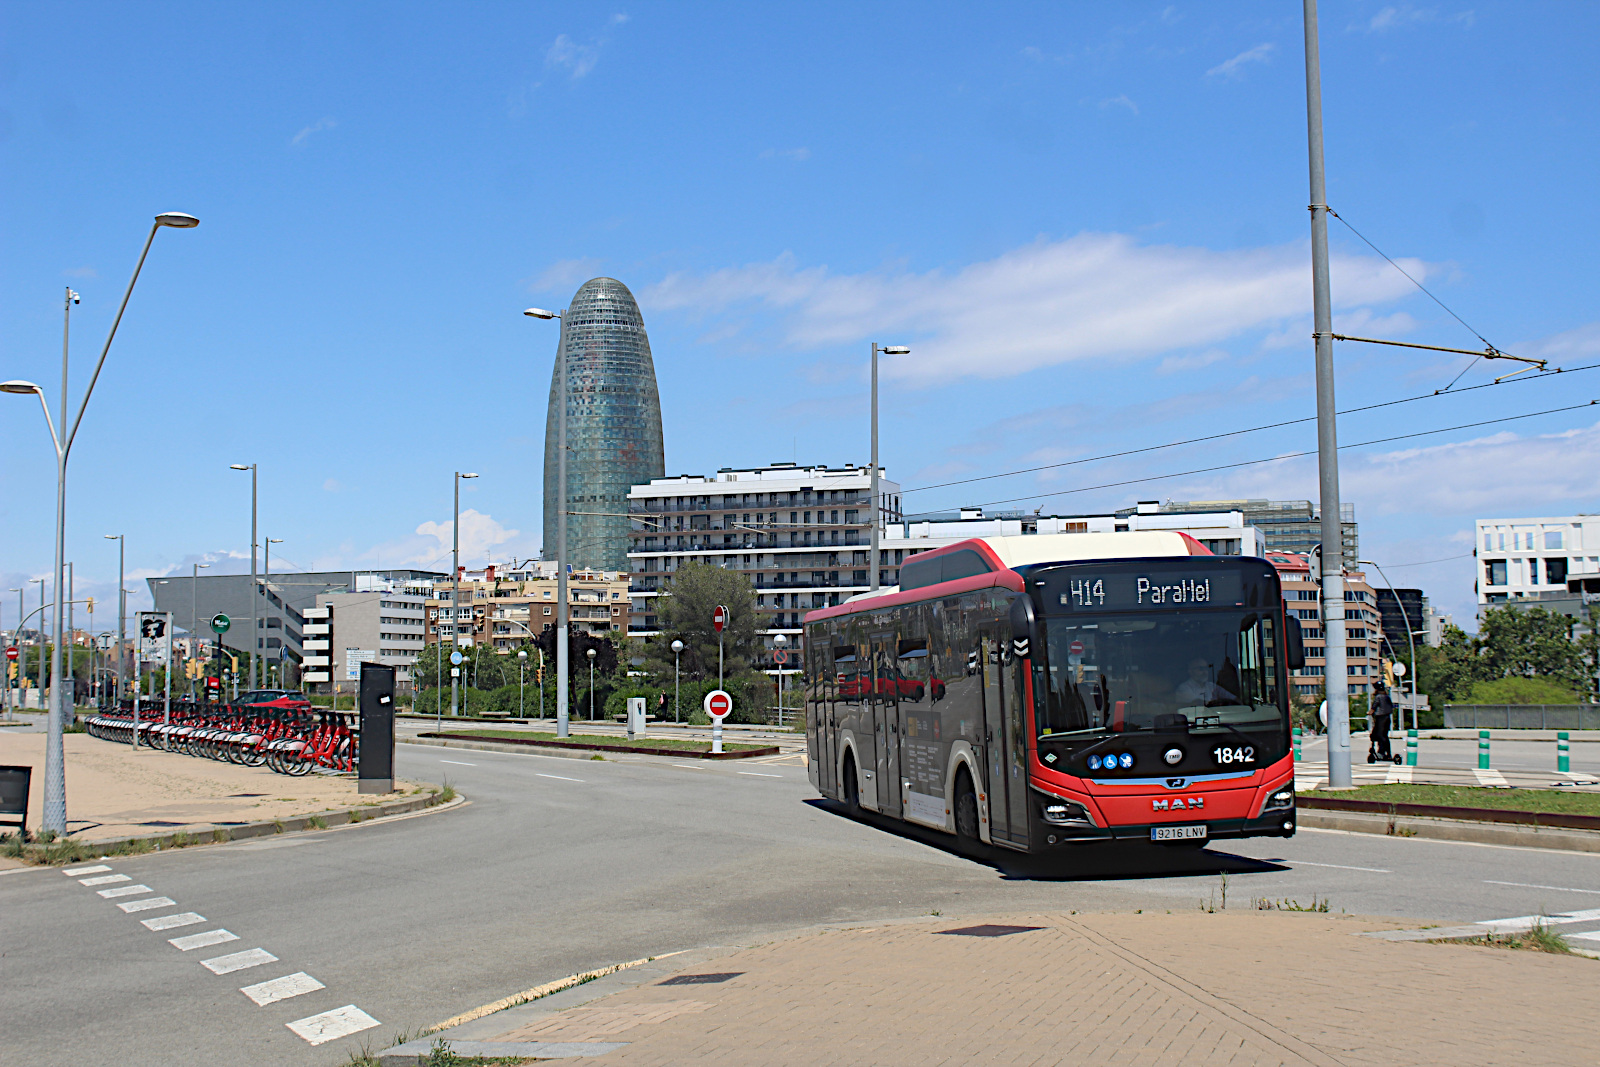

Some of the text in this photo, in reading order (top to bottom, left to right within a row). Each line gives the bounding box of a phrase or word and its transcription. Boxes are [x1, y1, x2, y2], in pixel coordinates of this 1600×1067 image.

[1070, 579, 1106, 606] H14
[1213, 746, 1255, 764] 1842
[1152, 797, 1204, 812] MAN
[1157, 827, 1205, 839] 9216 LNV
